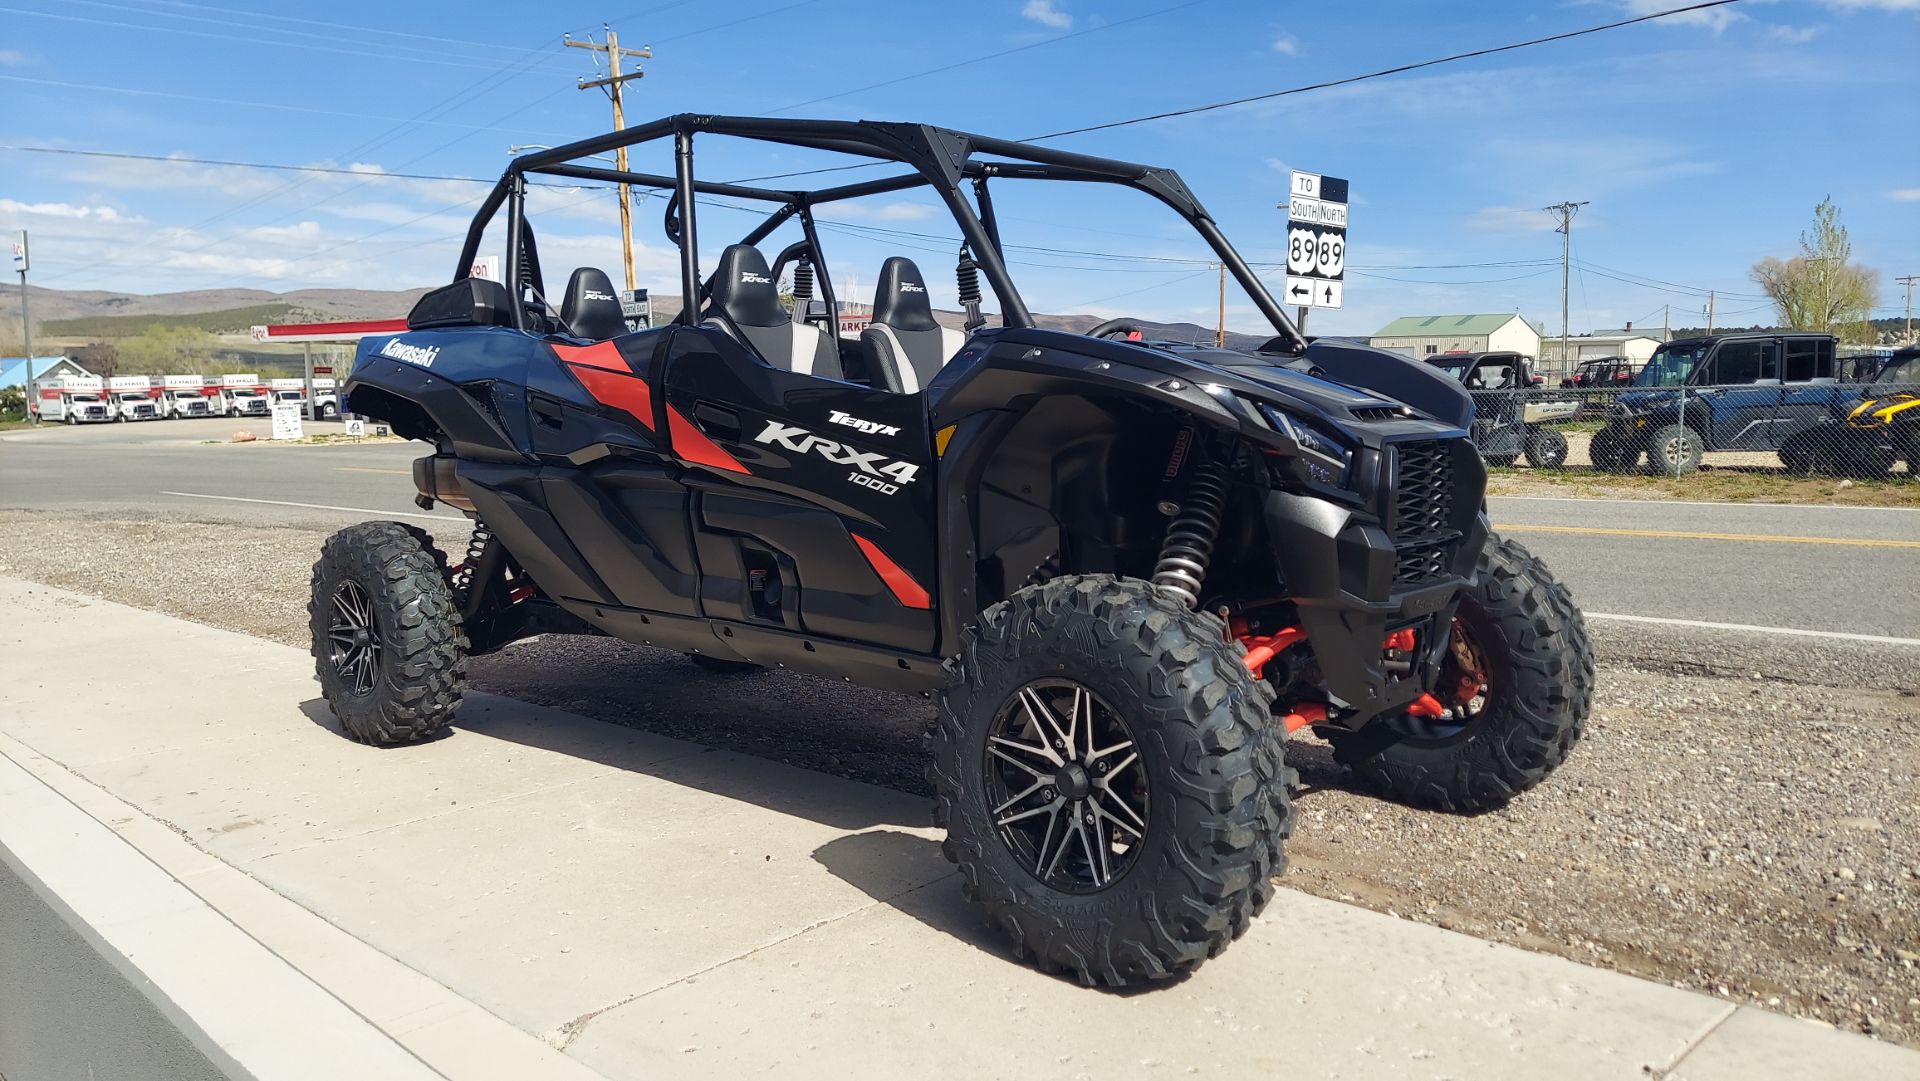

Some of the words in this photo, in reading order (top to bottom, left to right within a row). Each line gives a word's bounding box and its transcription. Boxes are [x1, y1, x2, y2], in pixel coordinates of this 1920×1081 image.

[1299, 177, 1313, 192] TO
[1291, 200, 1318, 219] SOUTH
[1320, 205, 1346, 222] NORTH
[1291, 237, 1314, 262] 89
[1320, 242, 1342, 266] 89
[741, 275, 771, 284] KRX
[900, 285, 924, 293] KRX
[841, 322, 873, 332] ARKE
[380, 337, 440, 368] Kawasaki
[754, 420, 919, 485] KRX4
[847, 471, 899, 495] 1000
